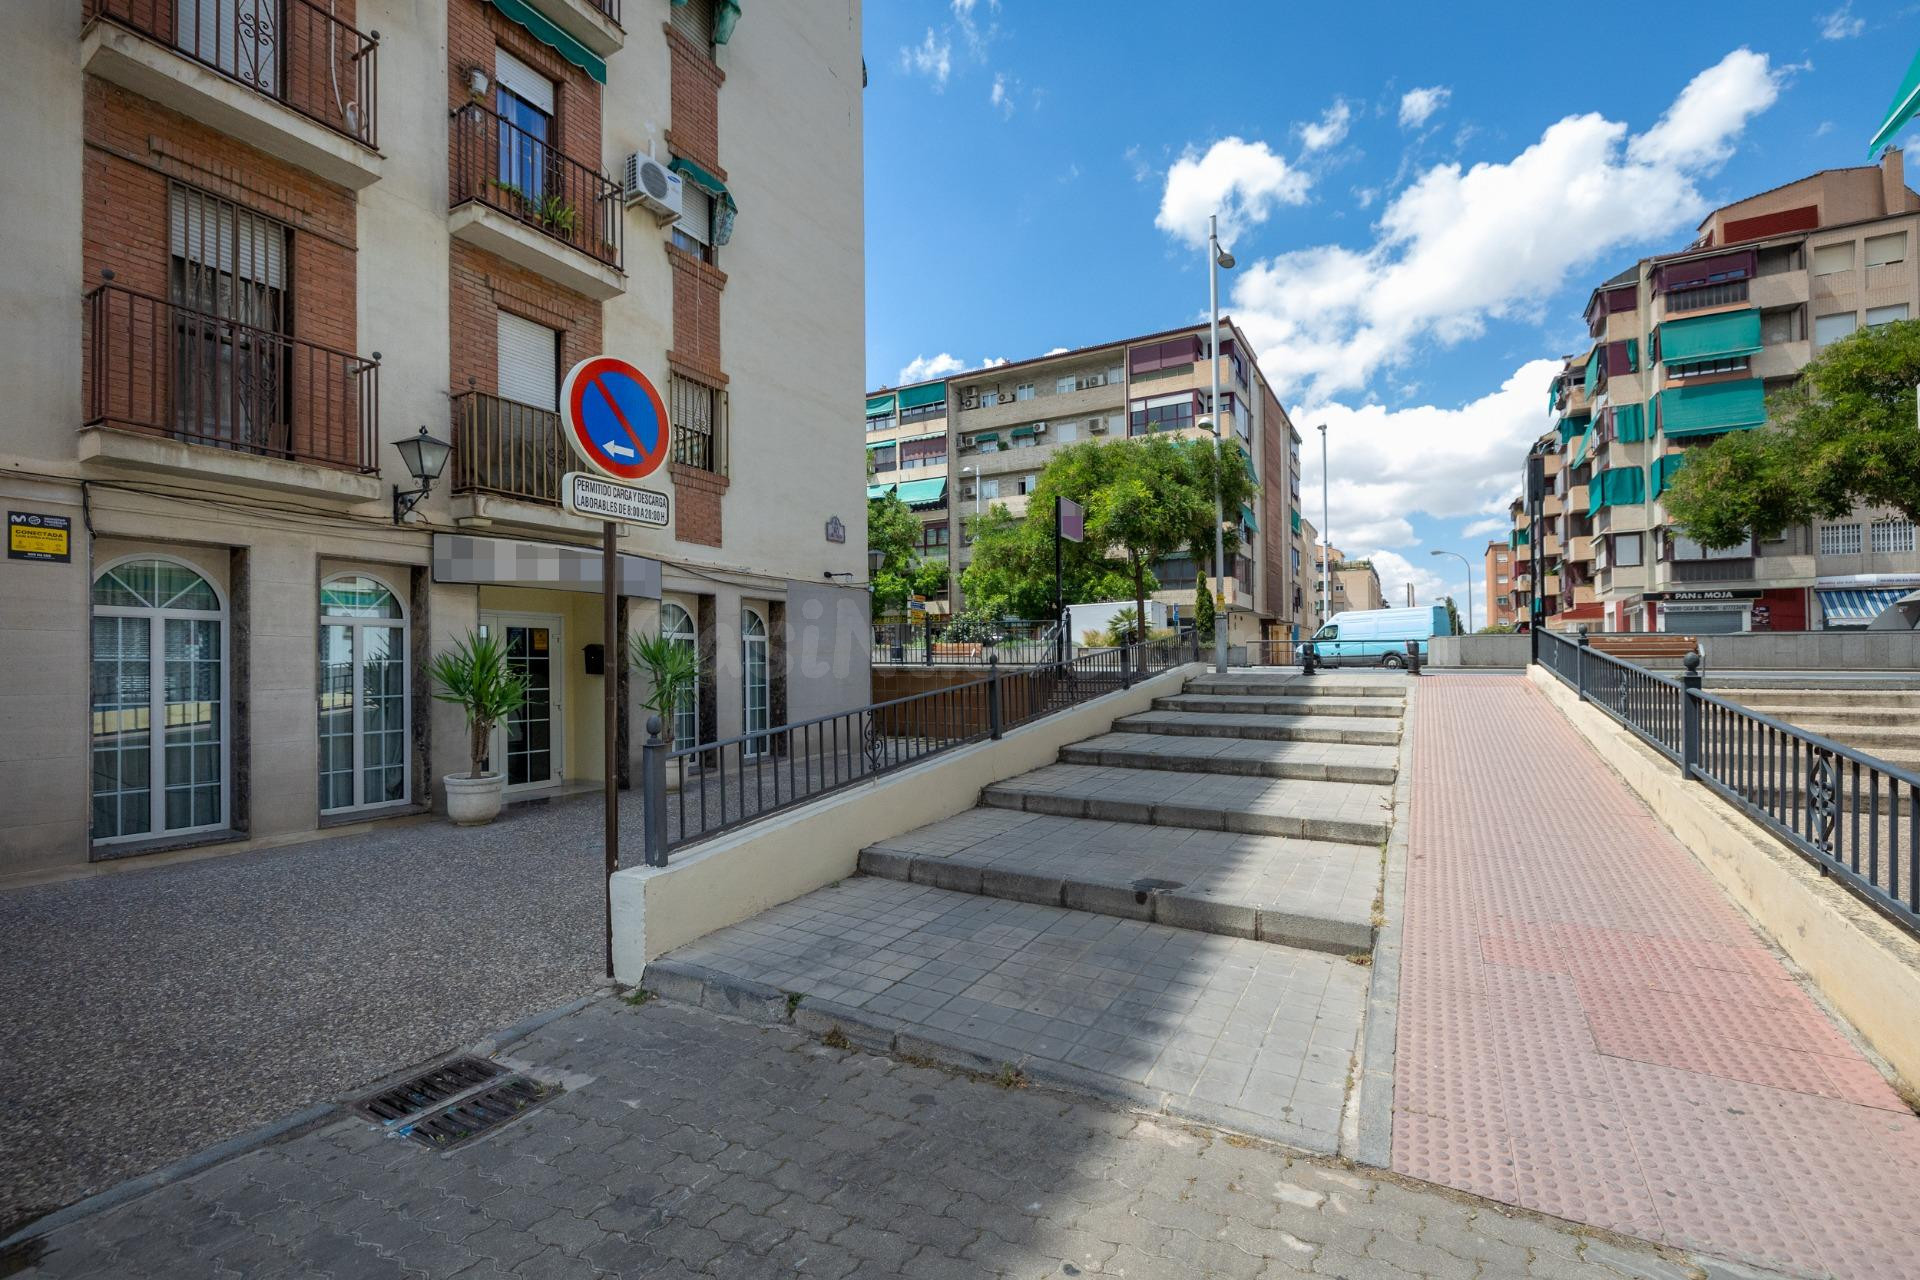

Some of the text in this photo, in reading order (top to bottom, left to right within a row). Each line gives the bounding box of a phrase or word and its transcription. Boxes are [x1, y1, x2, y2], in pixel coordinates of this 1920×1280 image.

[577, 479, 666, 508] PERMITIDO CARGA Y DESCARGA
[577, 496, 617, 512] LABORABLES
[619, 503, 626, 515] DE
[640, 508, 645, 518] A
[660, 511, 667, 522] H.
[15, 530, 63, 538] CONECTADA
[1704, 591, 1734, 599] MOJA
